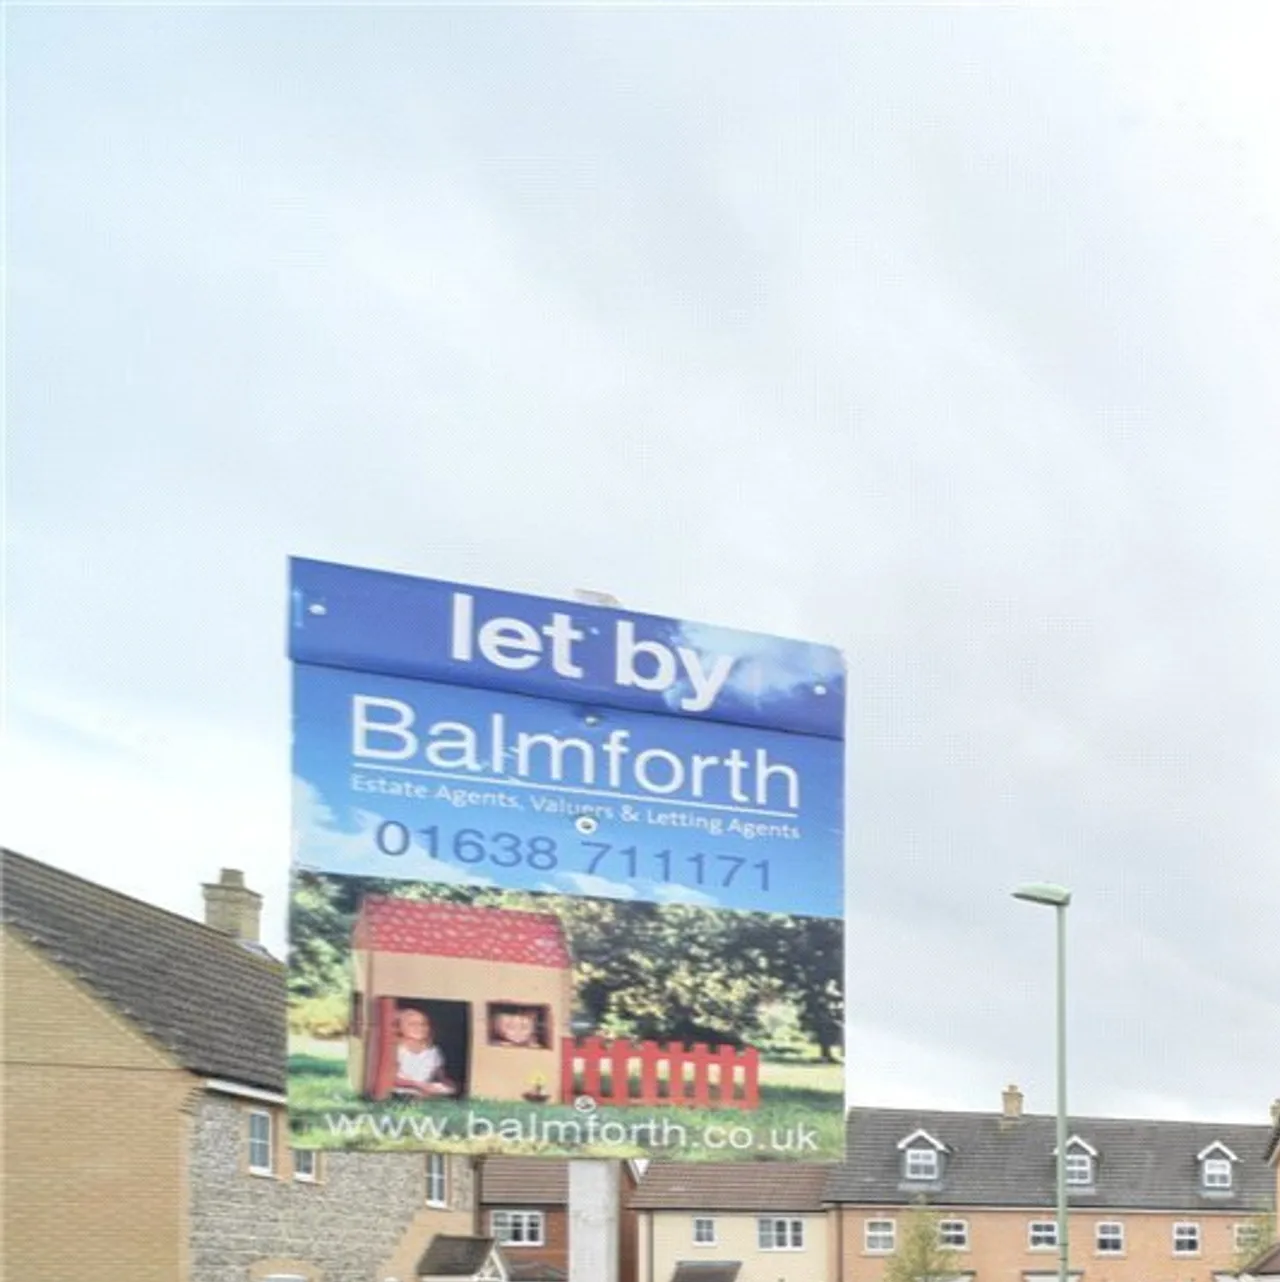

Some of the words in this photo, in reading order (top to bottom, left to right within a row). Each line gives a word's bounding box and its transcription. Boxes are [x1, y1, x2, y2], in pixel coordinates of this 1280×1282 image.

[450, 592, 584, 679] let
[615, 619, 737, 712] by
[351, 693, 801, 809] Balmforth
[351, 773, 428, 799] Estate
[530, 795, 614, 821] Valuers
[620, 804, 639, 822] &
[647, 808, 724, 836] Letting
[727, 818, 801, 840] Agents
[376, 819, 559, 871] 01638
[580, 839, 770, 892] 711171
[324, 1109, 819, 1153] www.balmforth.co.uk
